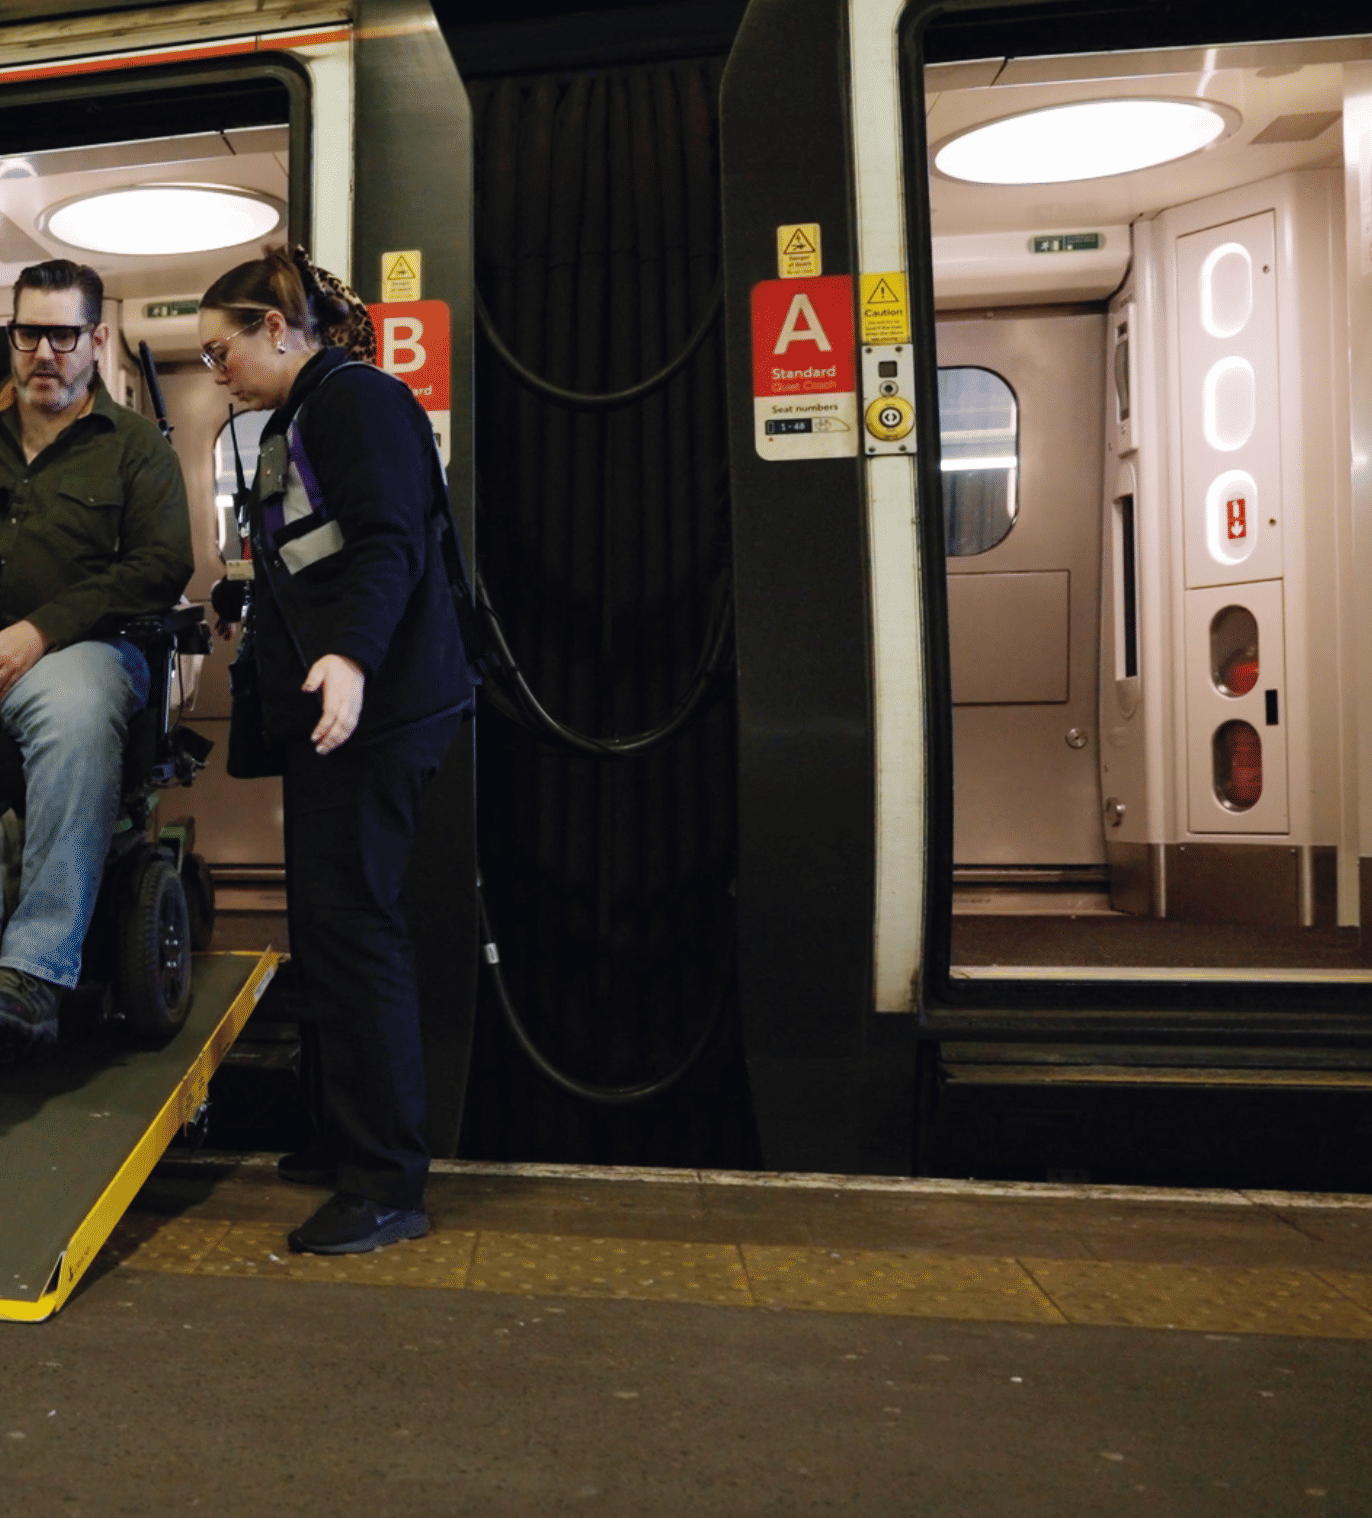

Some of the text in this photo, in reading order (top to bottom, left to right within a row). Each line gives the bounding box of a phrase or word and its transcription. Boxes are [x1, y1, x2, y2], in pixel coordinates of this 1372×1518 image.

[864, 308, 904, 318] Caution
[773, 294, 832, 355] A
[383, 316, 427, 374] B
[771, 365, 837, 381] Standard
[771, 403, 839, 415] Seat numbers
